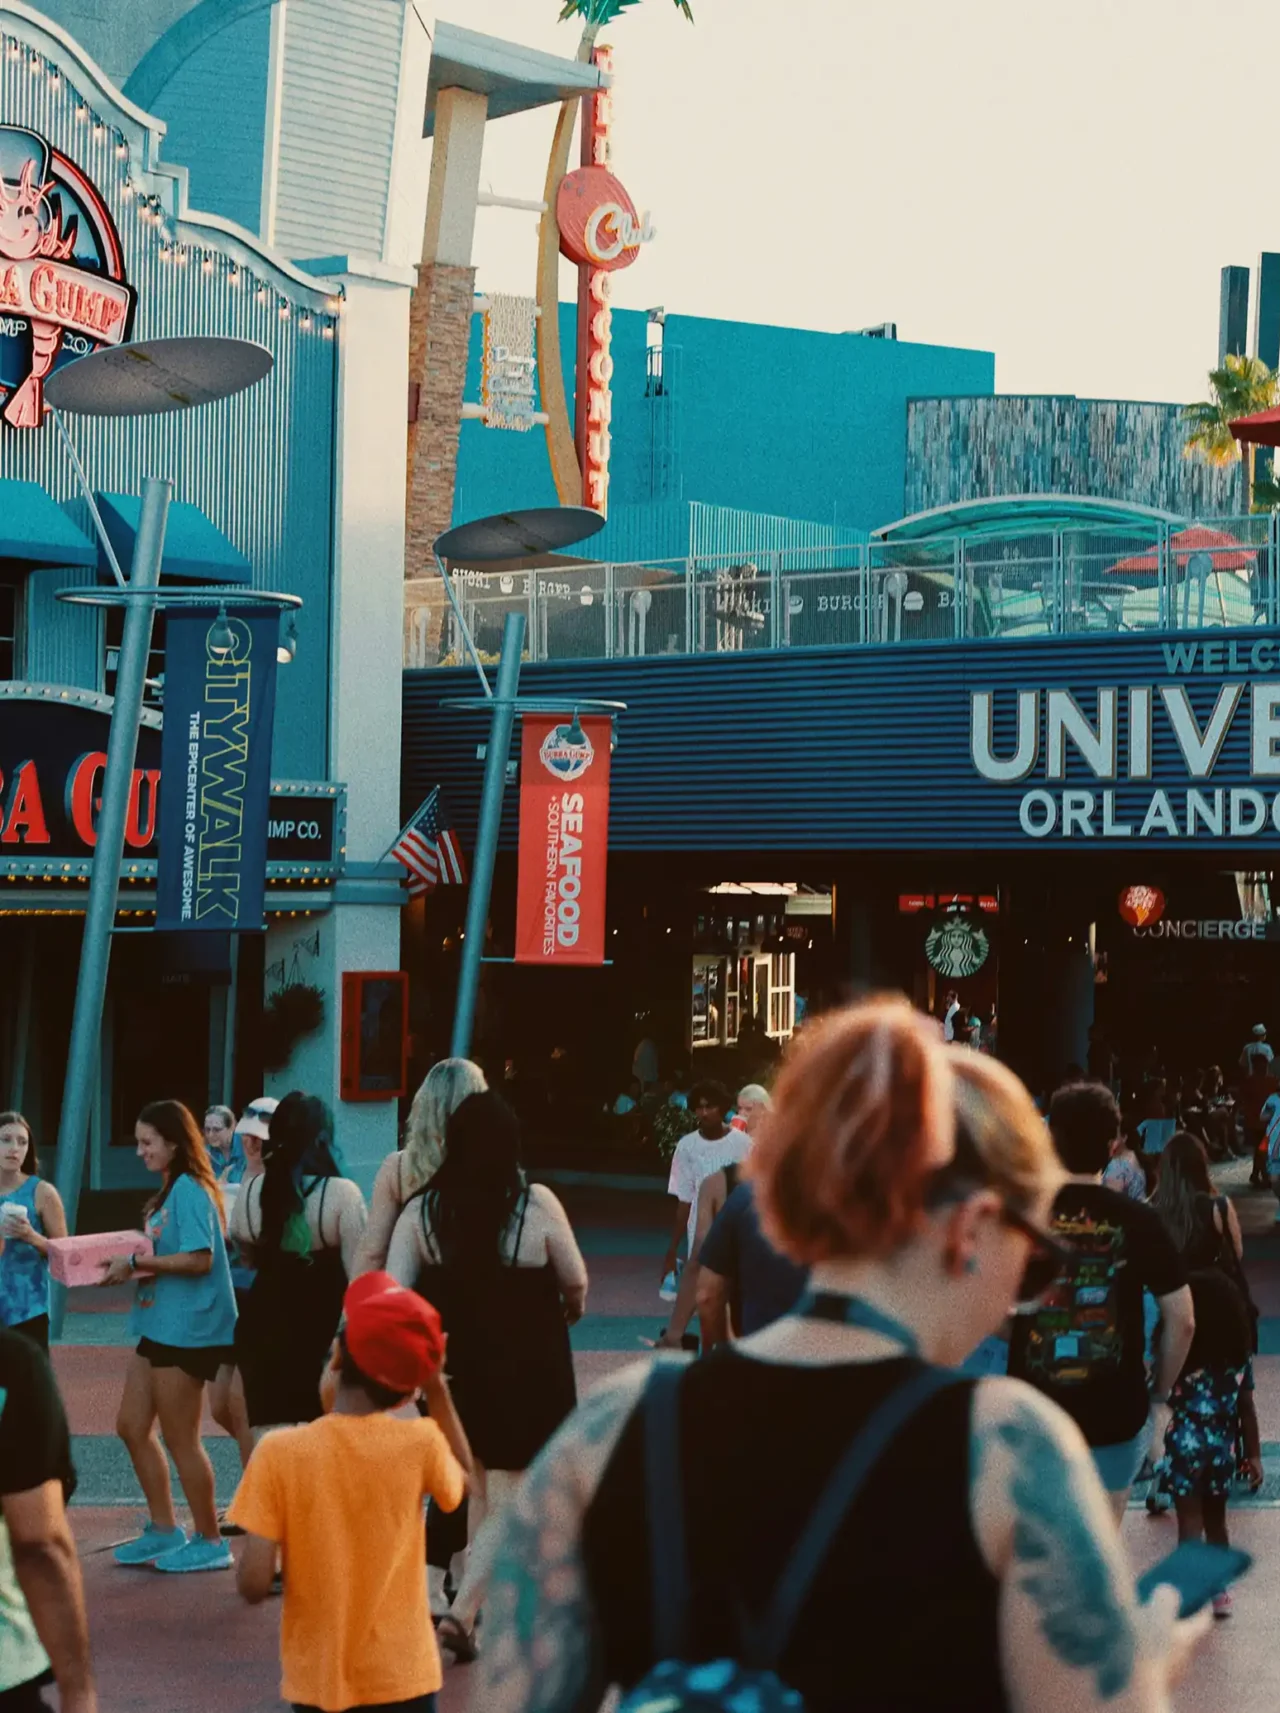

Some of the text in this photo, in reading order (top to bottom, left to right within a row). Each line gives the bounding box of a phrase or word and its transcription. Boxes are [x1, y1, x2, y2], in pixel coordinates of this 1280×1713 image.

[0, 263, 125, 332] A GUMP
[522, 578, 571, 600] BRGER
[0, 751, 161, 848] A GU
[181, 711, 200, 922] THE EPICENTER OF AWESOME.
[195, 617, 252, 921] CITYWALK
[267, 820, 322, 840] IMP CO.
[543, 802, 560, 956] SOUTHERN FAVORITES
[557, 792, 584, 947] SEAFOOD
